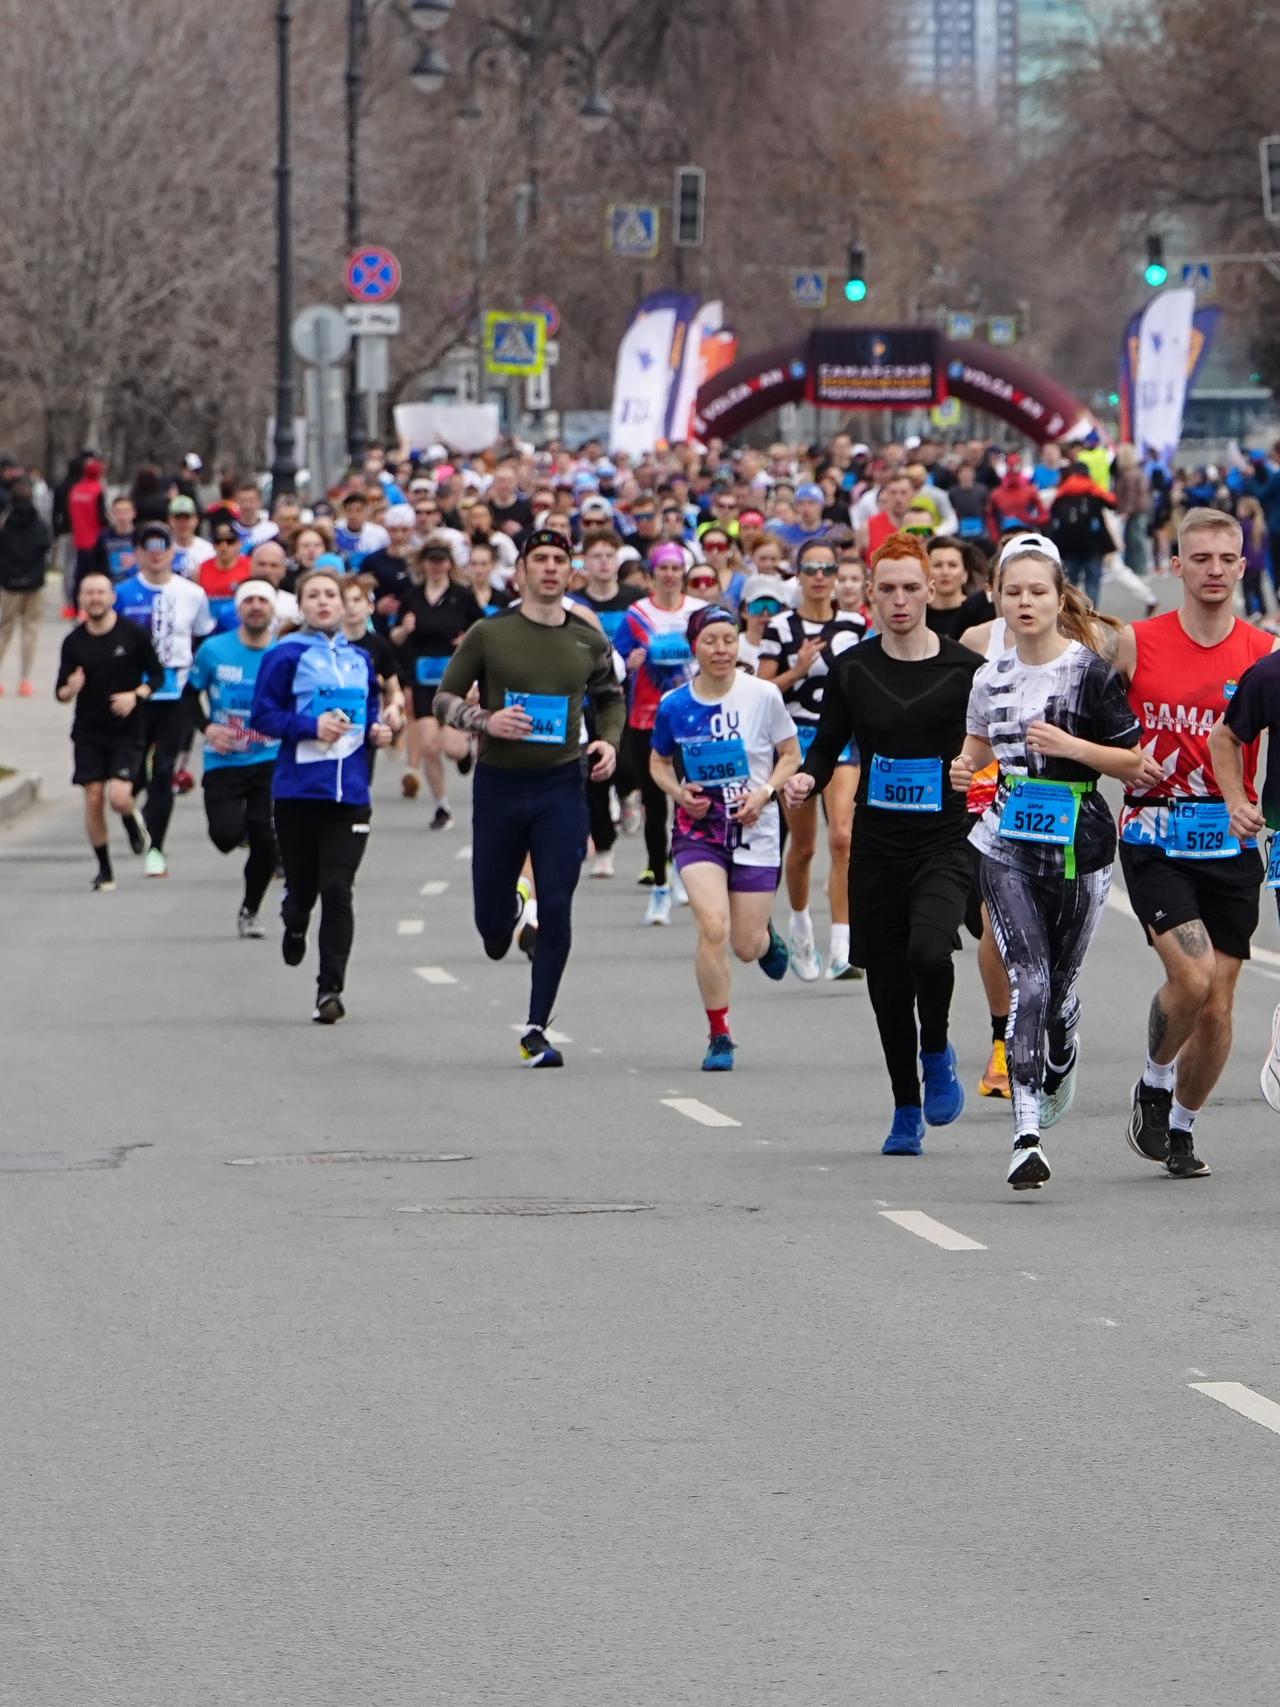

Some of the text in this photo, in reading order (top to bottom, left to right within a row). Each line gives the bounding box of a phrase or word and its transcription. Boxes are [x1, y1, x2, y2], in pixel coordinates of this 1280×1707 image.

[1143, 701, 1214, 736] SAMA
[698, 762, 736, 780] 5296
[874, 757, 893, 773] 10
[885, 784, 924, 803] 5017
[1014, 810, 1056, 833] 5122
[1174, 806, 1196, 819] 10
[1186, 830, 1224, 850] 5129
[1004, 967, 1020, 1040] BE STRONG
